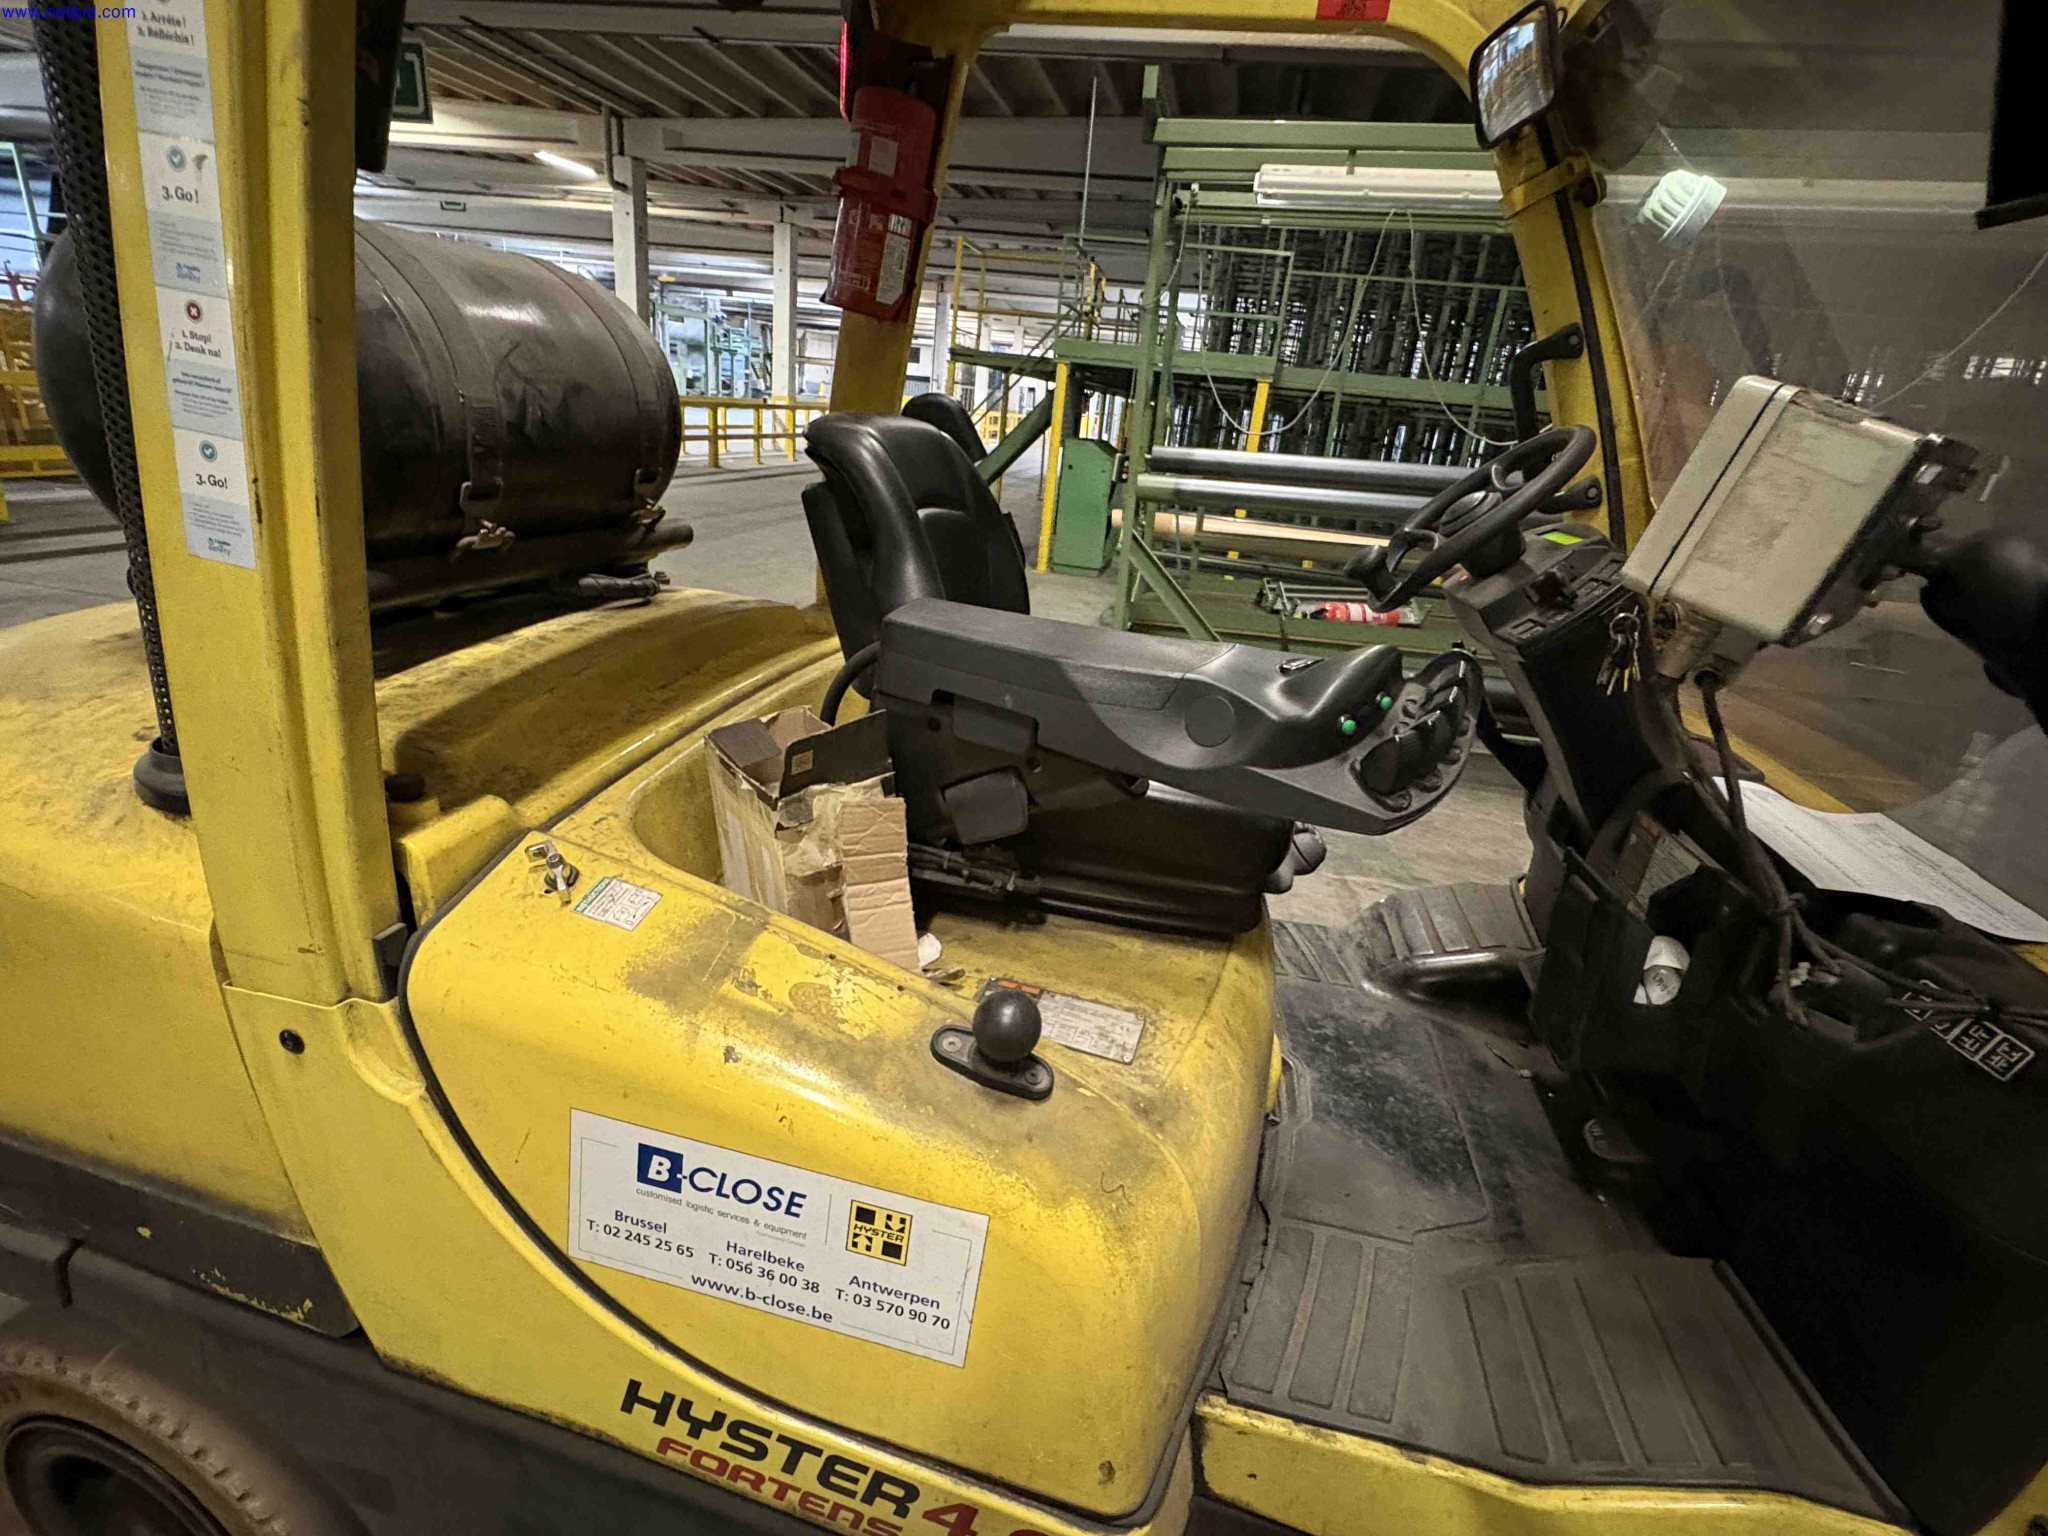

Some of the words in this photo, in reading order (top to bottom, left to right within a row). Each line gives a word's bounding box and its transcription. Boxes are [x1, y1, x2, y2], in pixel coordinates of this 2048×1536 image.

[161, 185, 173, 201] 3.
[174, 185, 193, 202] Go
[184, 342, 206, 355] Denk
[207, 348, 221, 358] na!
[195, 473, 206, 486] 3.
[207, 474, 228, 489] Go!
[614, 1209, 668, 1234] Brussel
[635, 1187, 683, 1206] customised
[685, 1198, 714, 1215] logistic
[717, 1209, 751, 1225] services
[753, 1218, 760, 1227] &
[763, 1222, 808, 1241] equipment
[853, 1223, 905, 1243] HYSTER
[586, 1218, 600, 1233] T:
[603, 1223, 621, 1239] 02
[624, 1228, 652, 1246] 245
[654, 1237, 673, 1252] 25
[676, 1243, 695, 1259] 65
[726, 1240, 805, 1273] Harelbeke
[708, 1252, 722, 1267] T:
[725, 1257, 753, 1275] 056
[757, 1266, 776, 1282] 36
[779, 1272, 798, 1288] 00
[801, 1278, 821, 1294] 38
[848, 1274, 941, 1310] Antwerpen
[691, 1274, 834, 1324] www.b-close.be
[835, 1287, 850, 1303] T:
[853, 1293, 872, 1308] 03
[876, 1299, 905, 1317] 570
[908, 1308, 928, 1324] 90
[931, 1314, 951, 1331] 70
[620, 1378, 921, 1519] HYSTER
[656, 1437, 905, 1536] FORTENS
